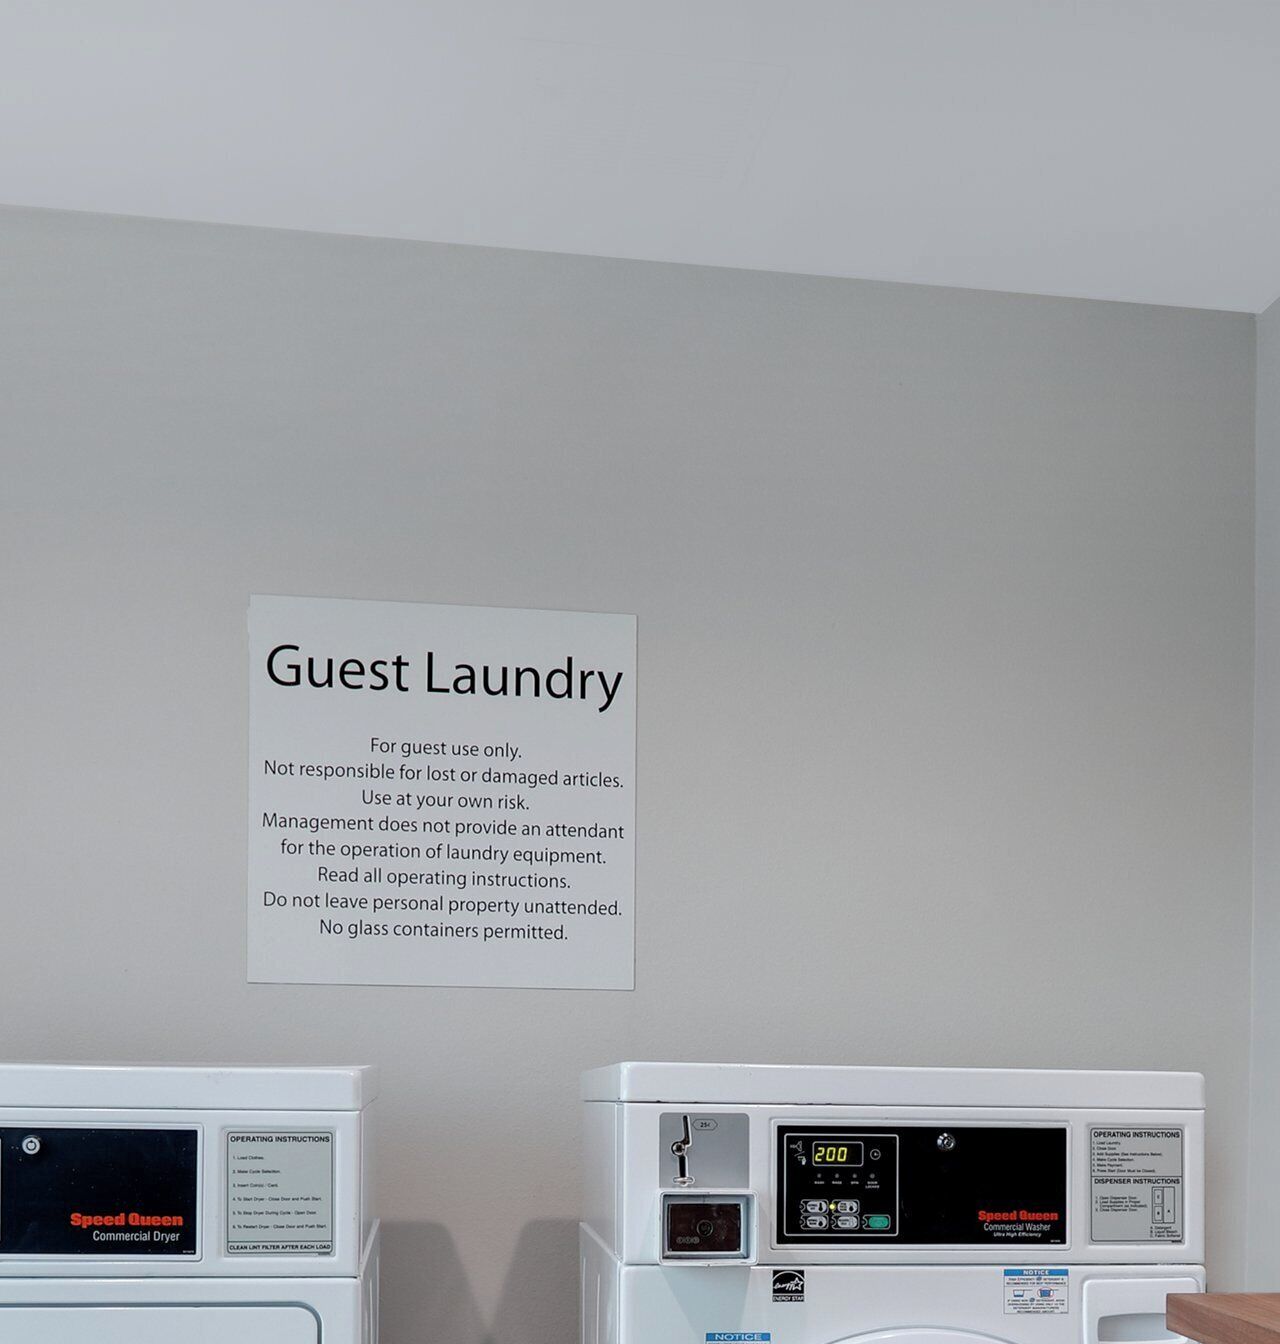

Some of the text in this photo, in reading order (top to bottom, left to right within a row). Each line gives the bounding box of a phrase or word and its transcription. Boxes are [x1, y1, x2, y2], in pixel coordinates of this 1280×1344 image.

[267, 644, 623, 713] Guest Laundry
[371, 738, 521, 762] For guest use only.
[265, 760, 623, 788] Not responsible for lost or damaged articles.
[362, 789, 529, 810] Use at your own risk.
[263, 812, 624, 839] Management does not provide an attendant
[281, 838, 606, 866] for the operation of laundry equipment.
[319, 867, 570, 889] Read all operating instructions.
[264, 891, 621, 917] Do not leave personal property unattended.
[320, 919, 567, 942] No glass containers permitted.
[815, 1147, 848, 1162] 200
[70, 1213, 183, 1228] Speed Queen
[978, 1210, 1058, 1222] Speed Queen
[984, 1223, 1051, 1231] Commercial Washer
[93, 1231, 180, 1243] Commercial Dryer
